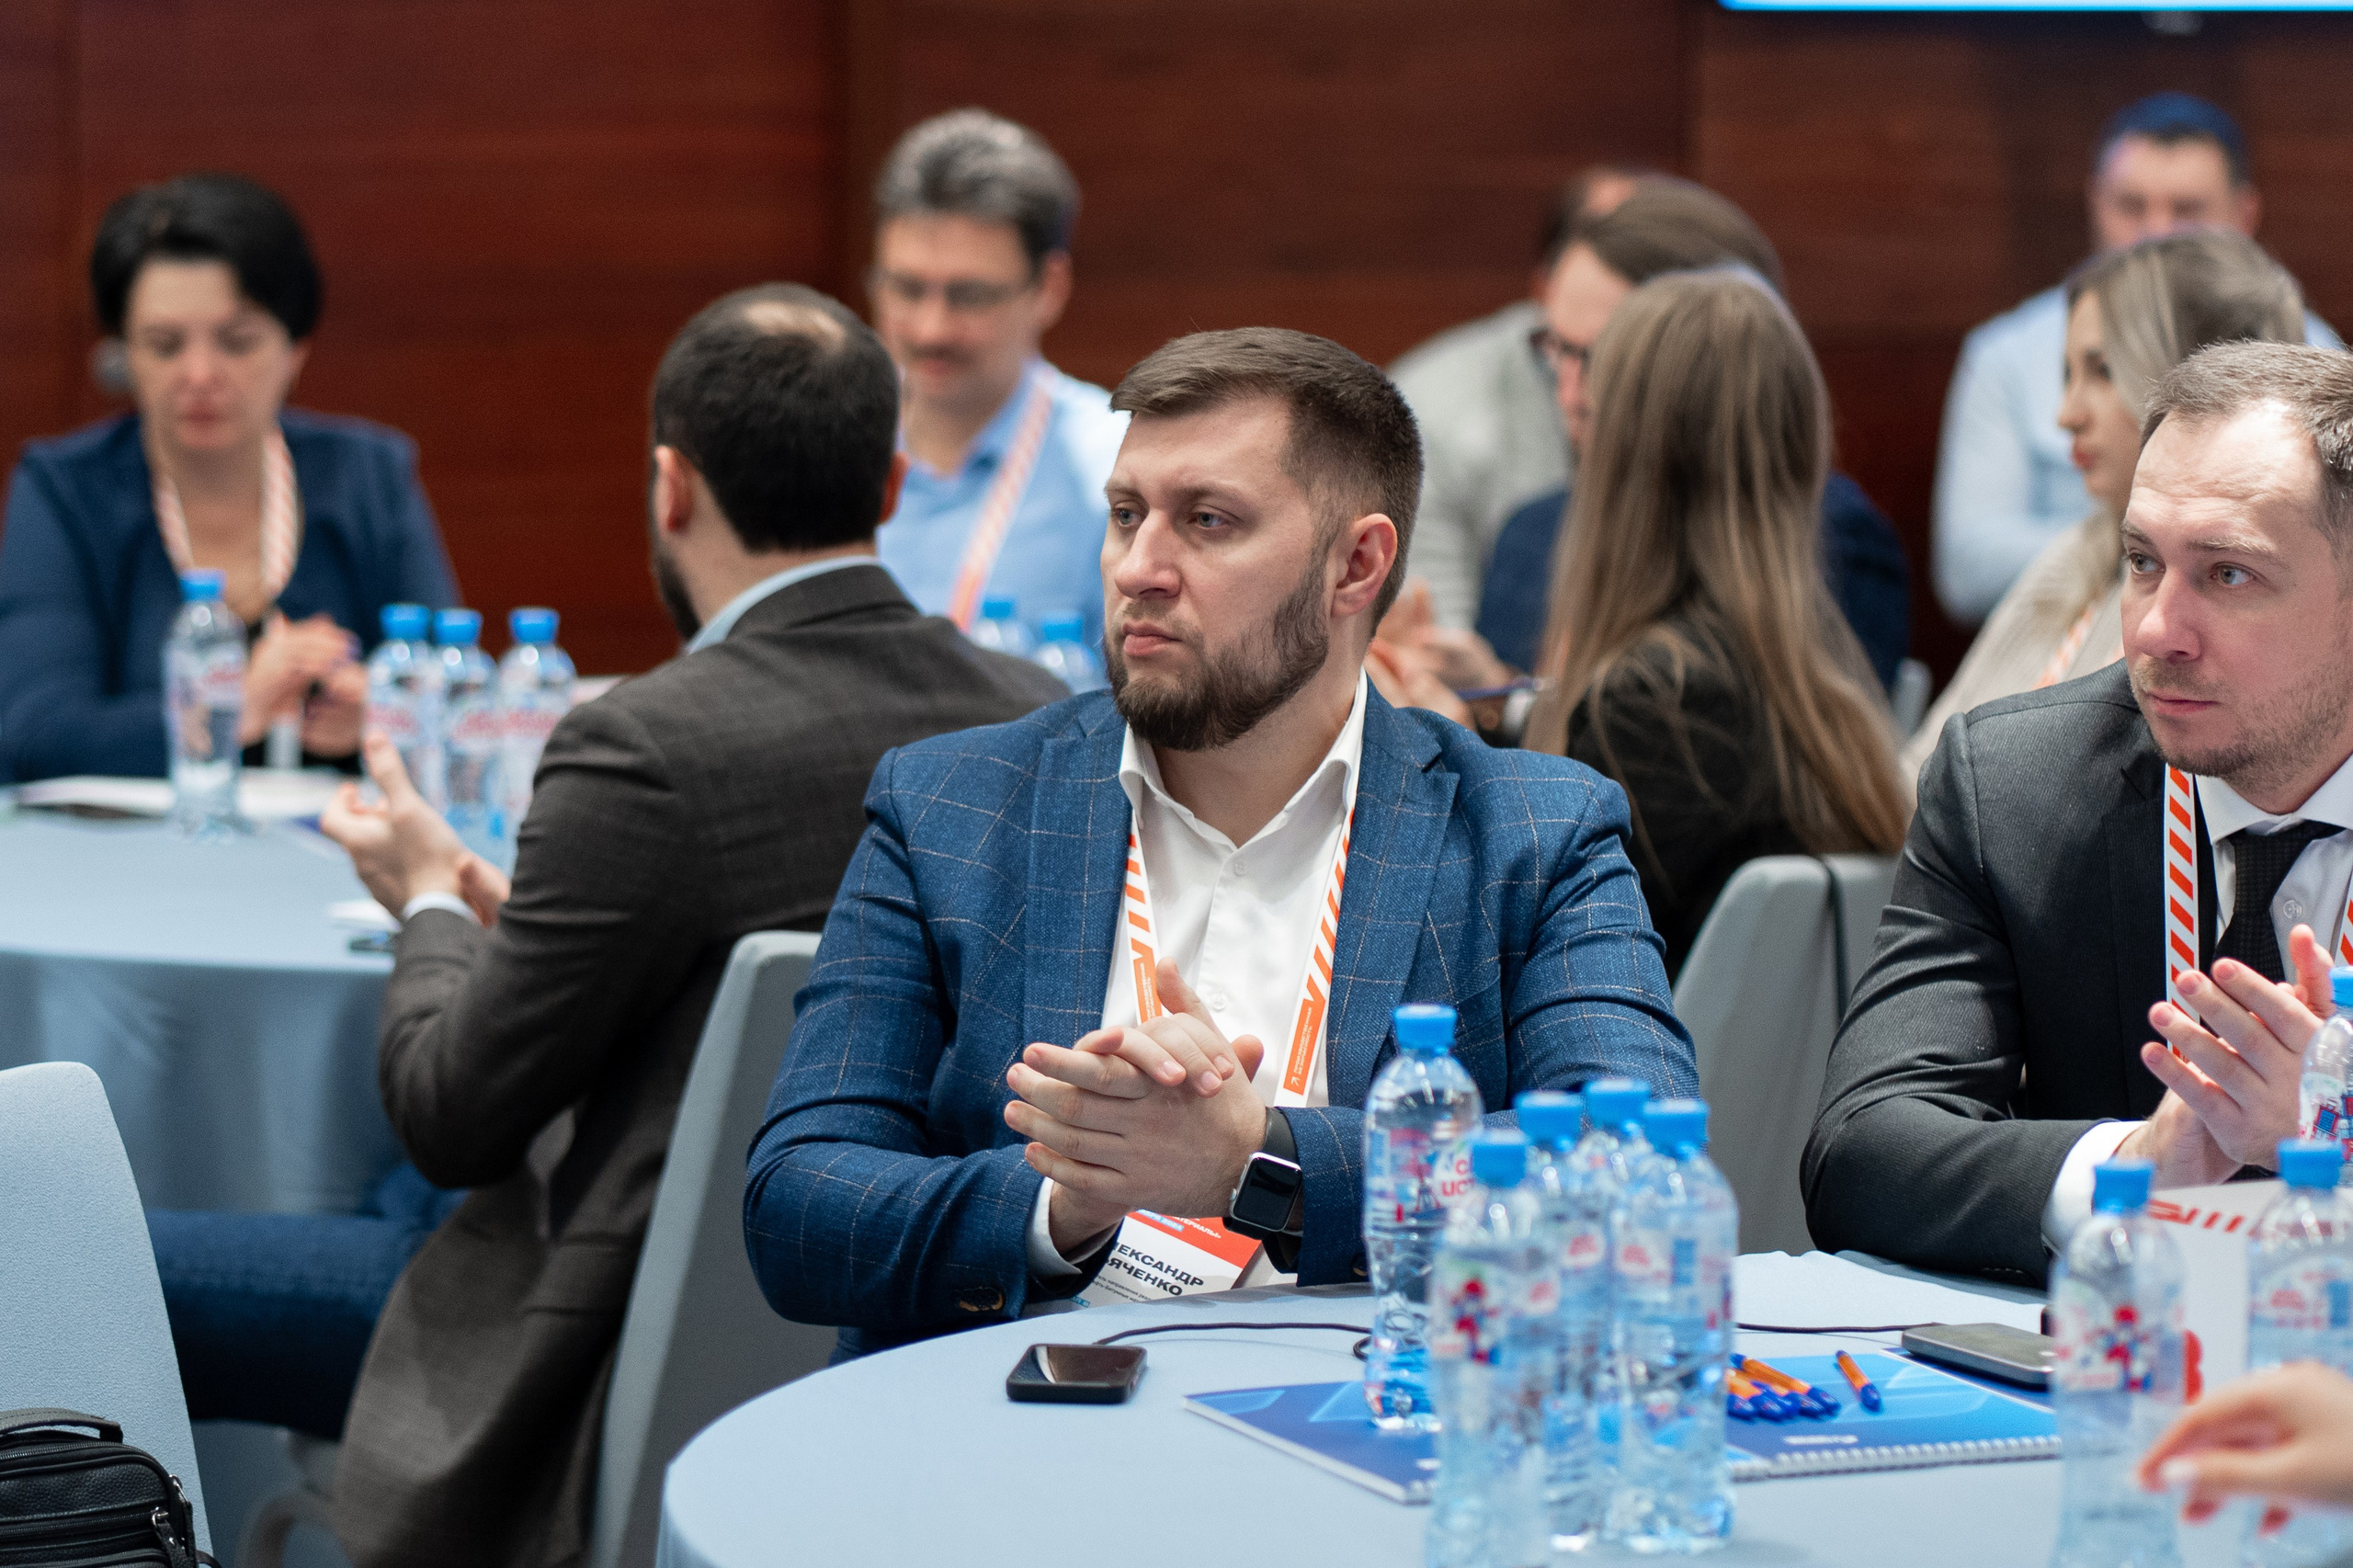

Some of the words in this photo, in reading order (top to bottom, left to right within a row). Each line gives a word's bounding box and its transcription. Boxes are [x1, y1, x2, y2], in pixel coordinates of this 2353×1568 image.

[1293, 1006, 1313, 1074] ПРОИЗВОДСТВЕННАЯ
[1298, 1026, 1313, 1075] БЕЗОПАСНОСТЬ
[1107, 1256, 1183, 1296] ЯЧЕНКО
